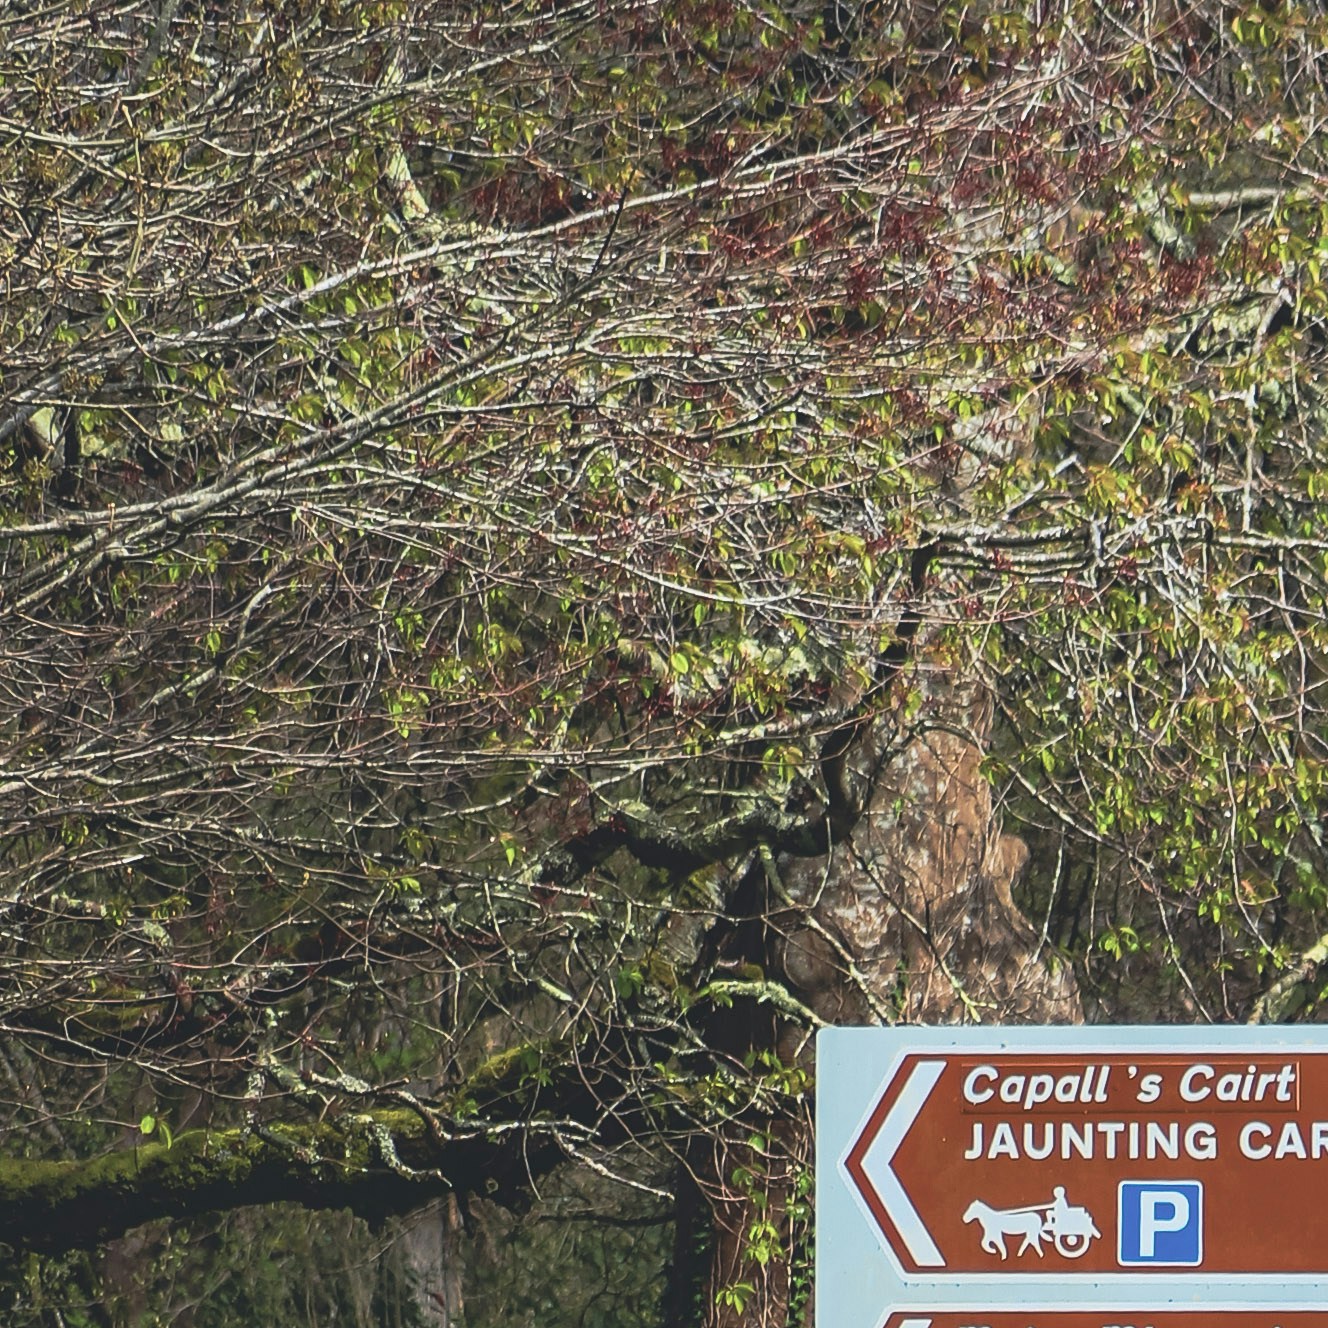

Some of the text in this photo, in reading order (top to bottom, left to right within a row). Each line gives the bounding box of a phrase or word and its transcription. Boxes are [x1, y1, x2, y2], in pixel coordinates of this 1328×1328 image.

[963, 1064, 1108, 1110] Capall
[1179, 1064, 1296, 1103] Cairt
[964, 1123, 1217, 1160] JAUNTING
[1139, 1190, 1190, 1257] P
